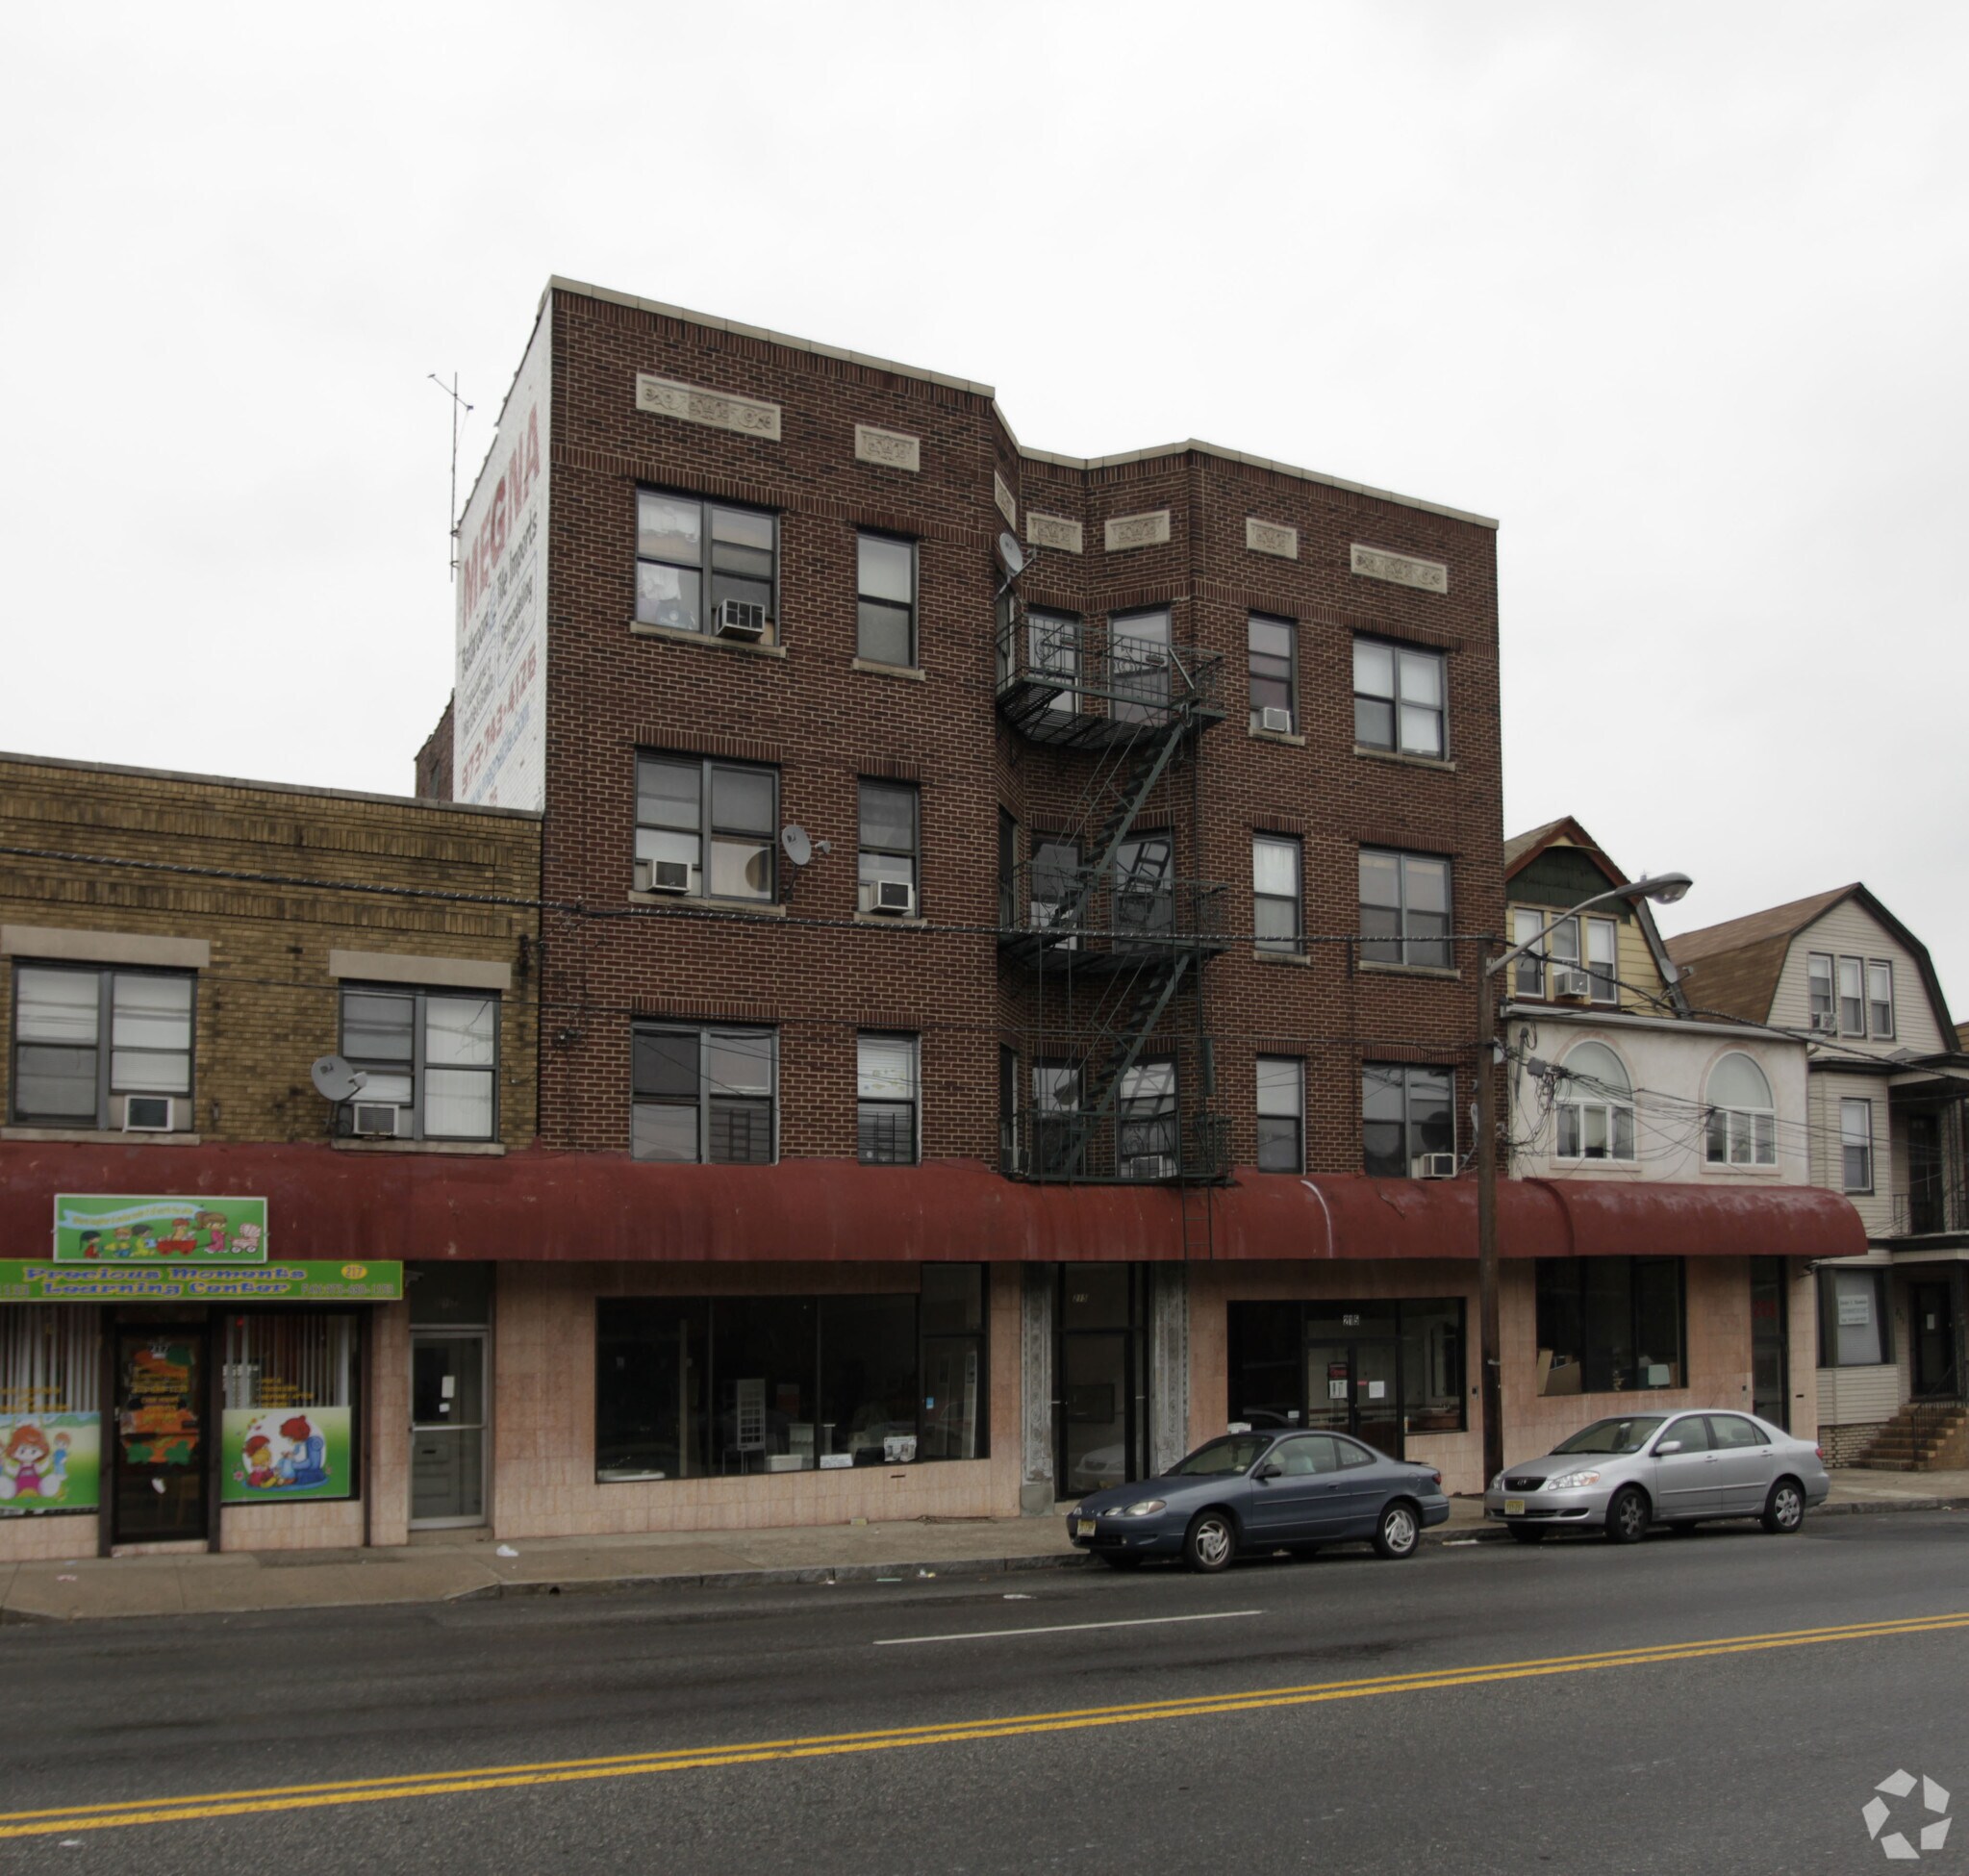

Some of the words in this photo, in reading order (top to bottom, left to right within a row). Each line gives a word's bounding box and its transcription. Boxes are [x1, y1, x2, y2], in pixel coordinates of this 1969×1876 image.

[464, 402, 541, 631] MEGNA
[509, 507, 537, 586] Imports
[24, 1267, 162, 1281] Precious
[167, 1266, 307, 1280] Moments
[42, 1281, 183, 1297] Learning
[188, 1281, 291, 1296] Center
